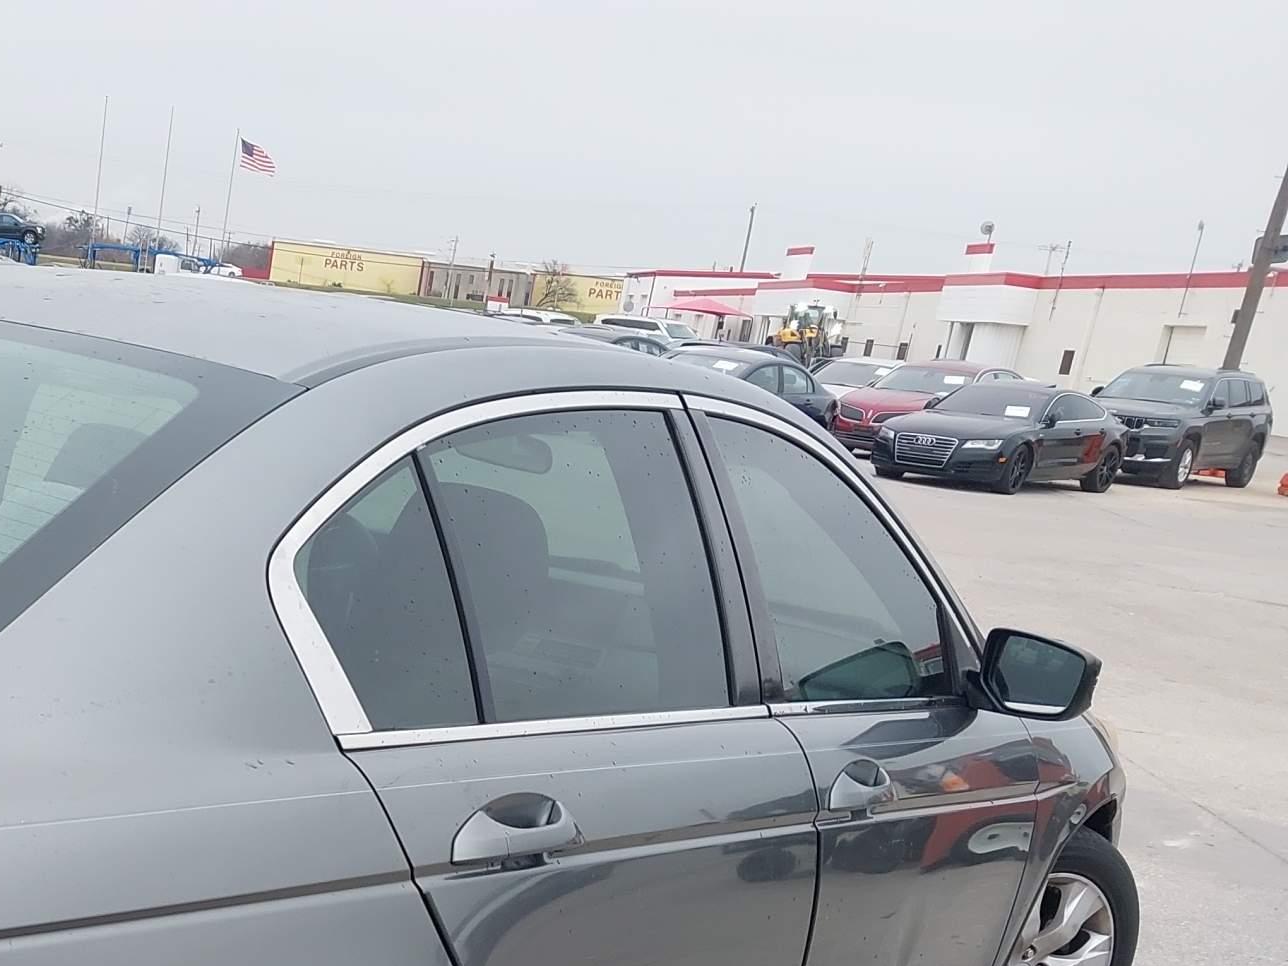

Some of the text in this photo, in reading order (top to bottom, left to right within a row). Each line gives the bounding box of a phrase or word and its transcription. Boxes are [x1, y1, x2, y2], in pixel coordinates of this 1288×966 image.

[331, 251, 362, 261] FOREIGN
[324, 258, 365, 272] PARTS
[595, 281, 623, 290] FOREIG
